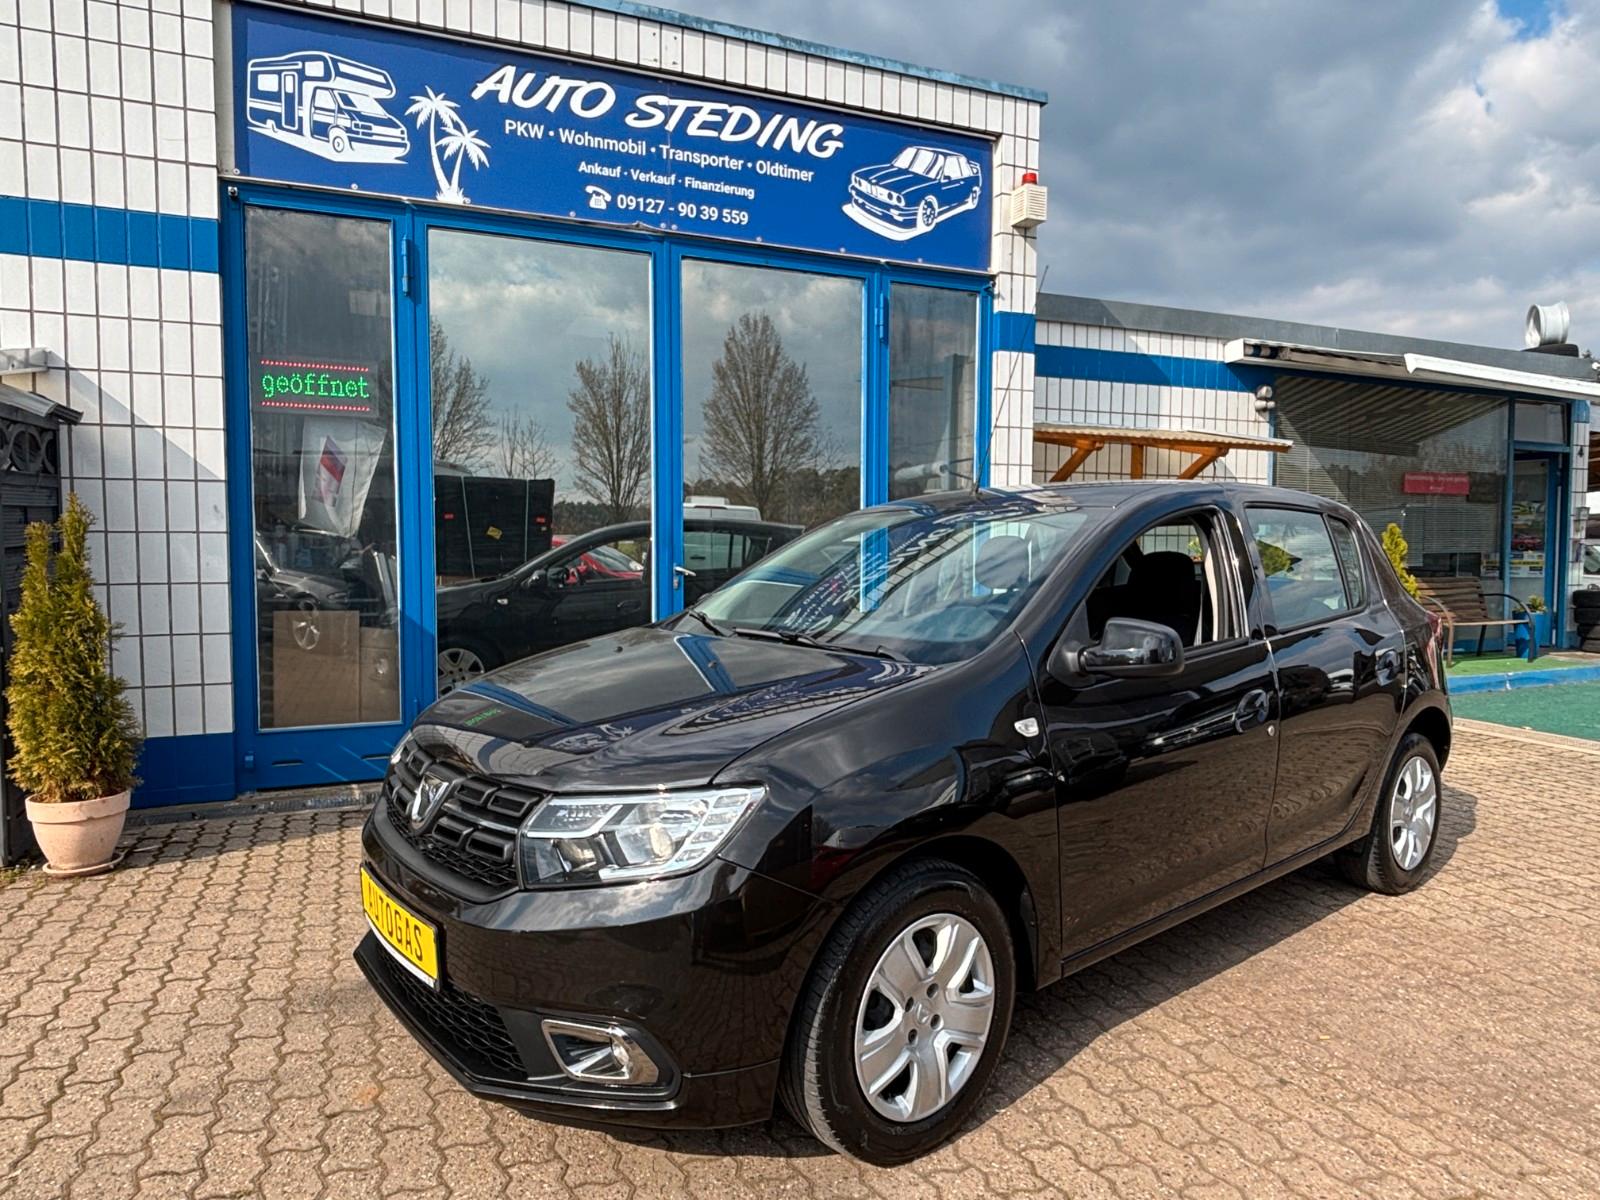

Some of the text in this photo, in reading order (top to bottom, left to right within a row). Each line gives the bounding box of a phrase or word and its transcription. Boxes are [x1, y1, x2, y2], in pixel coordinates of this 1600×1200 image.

[470, 64, 844, 159] AUTO STEDING
[504, 119, 815, 183] PKW Wohnmobil Transporter Oldtimer
[578, 160, 756, 200] Ankauf Verkauf Finanzierung
[616, 194, 666, 215] 09127
[677, 202, 698, 219] 90
[700, 205, 720, 222] 39
[722, 208, 750, 226] 559
[262, 373, 370, 398] geöffnet
[367, 881, 424, 963] AUTOGAS
